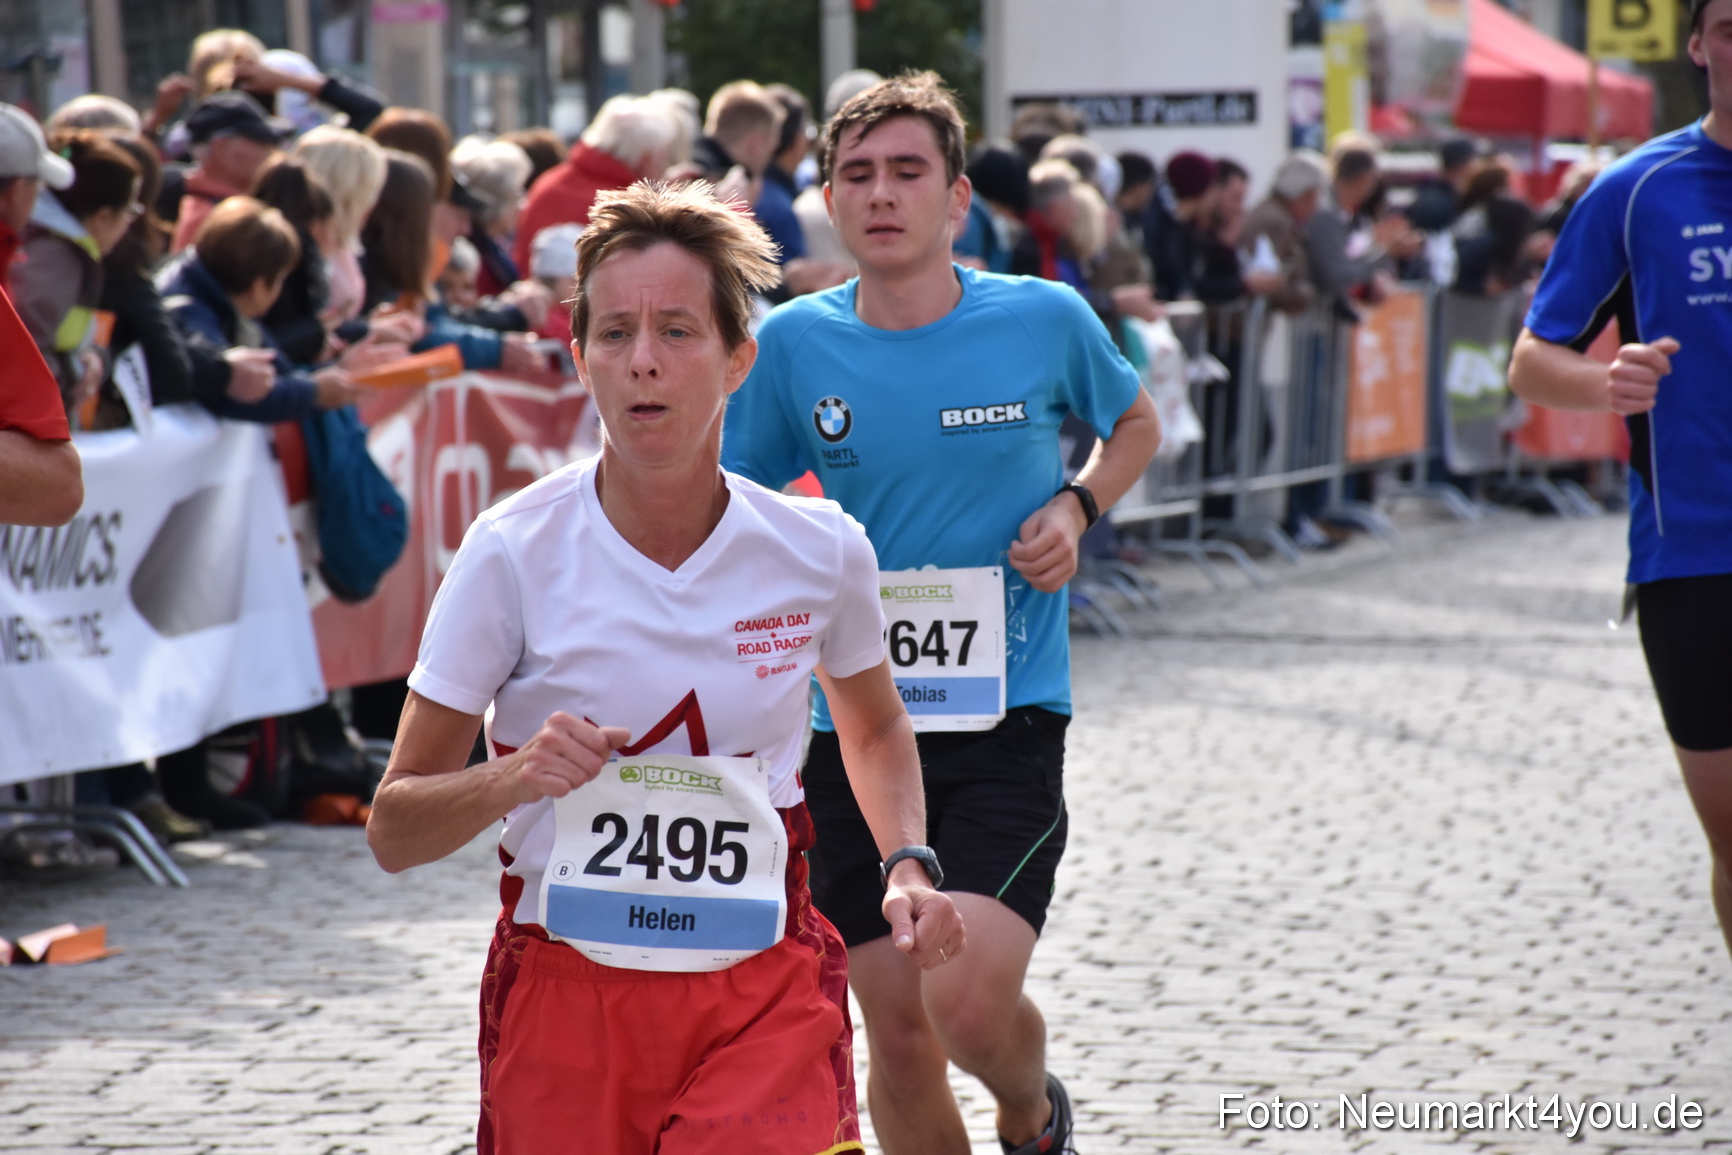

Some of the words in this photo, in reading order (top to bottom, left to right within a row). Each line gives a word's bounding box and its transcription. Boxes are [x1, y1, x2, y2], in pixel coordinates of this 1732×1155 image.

[939, 403, 1028, 429] BOCK
[826, 459, 860, 469] eumarkt
[895, 584, 953, 599] BOCK
[734, 616, 785, 633] CANADA
[787, 612, 811, 627] DAY
[737, 641, 772, 657] ROAD
[883, 619, 979, 668] 647
[643, 766, 723, 792] BOCK
[583, 812, 750, 885] 2495
[558, 865, 569, 877] B
[628, 904, 696, 932] Helen
